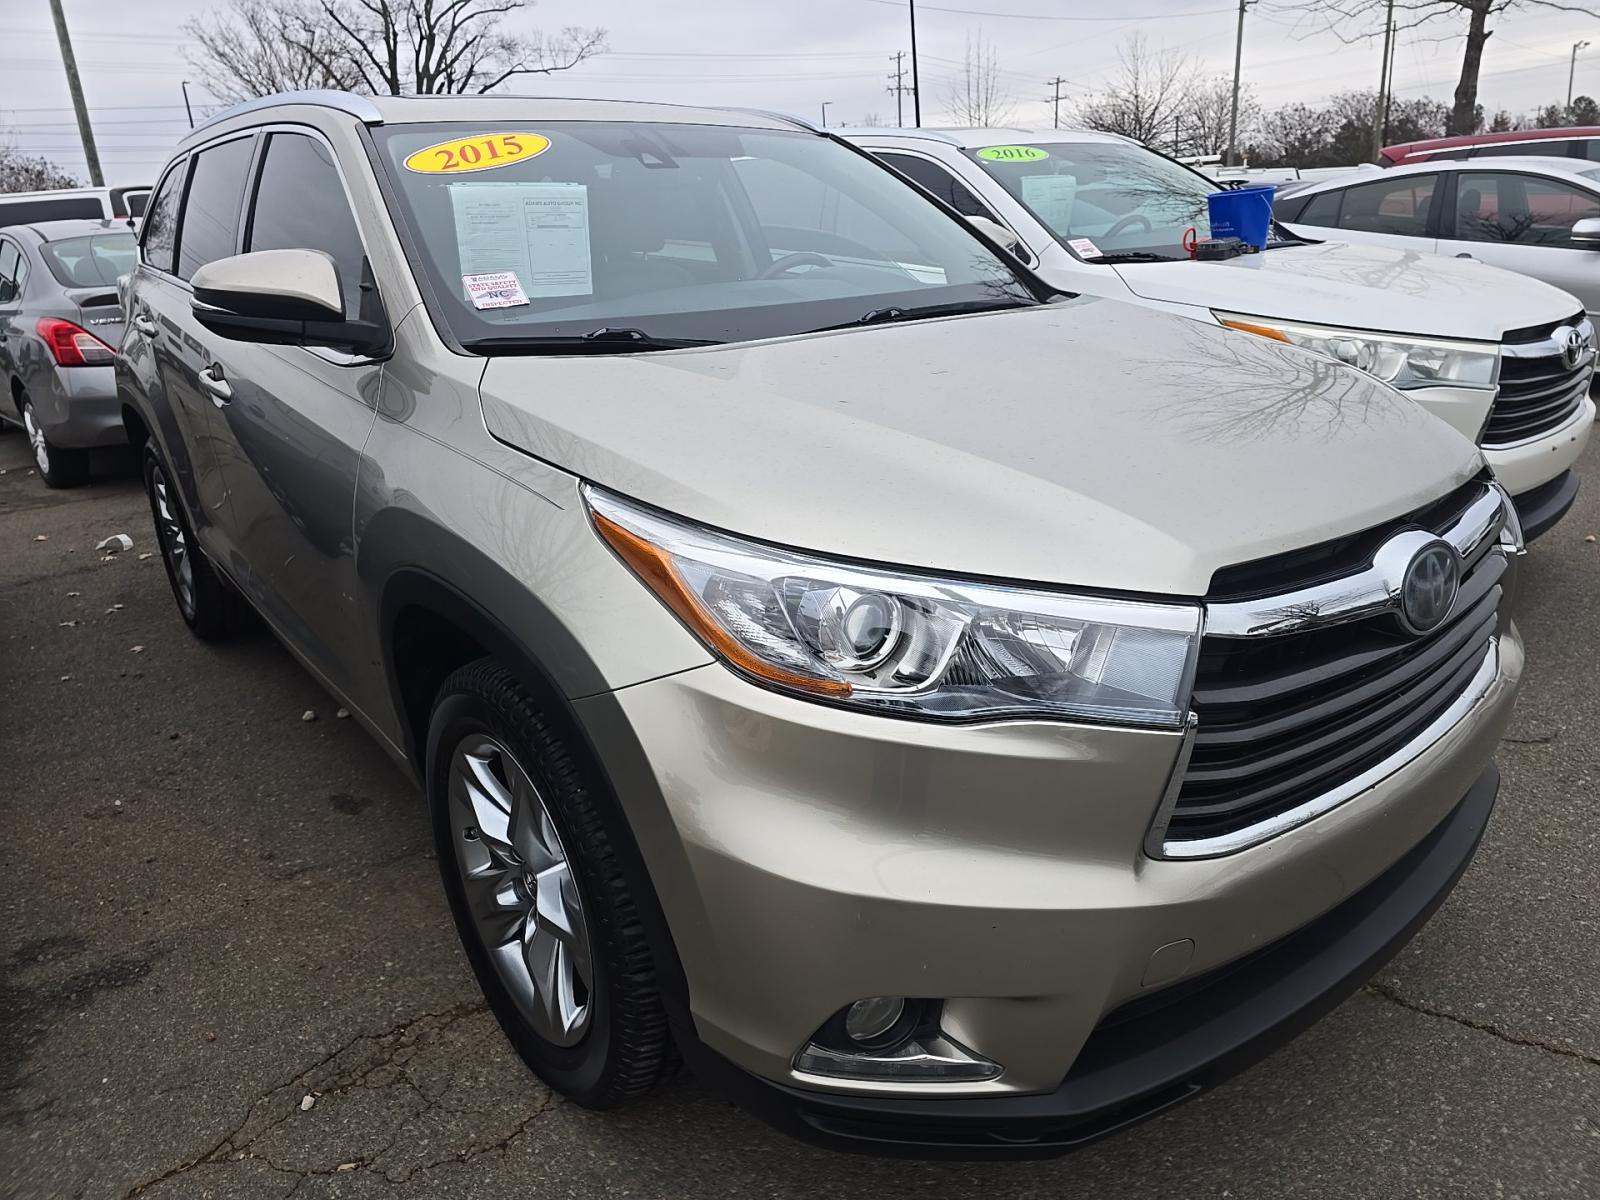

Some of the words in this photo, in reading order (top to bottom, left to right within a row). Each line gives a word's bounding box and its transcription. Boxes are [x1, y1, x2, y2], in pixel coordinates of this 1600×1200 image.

[435, 136, 523, 169] 2015
[992, 149, 1036, 159] 2016
[488, 290, 510, 298] NC
[481, 299, 522, 307] INSPECTED
